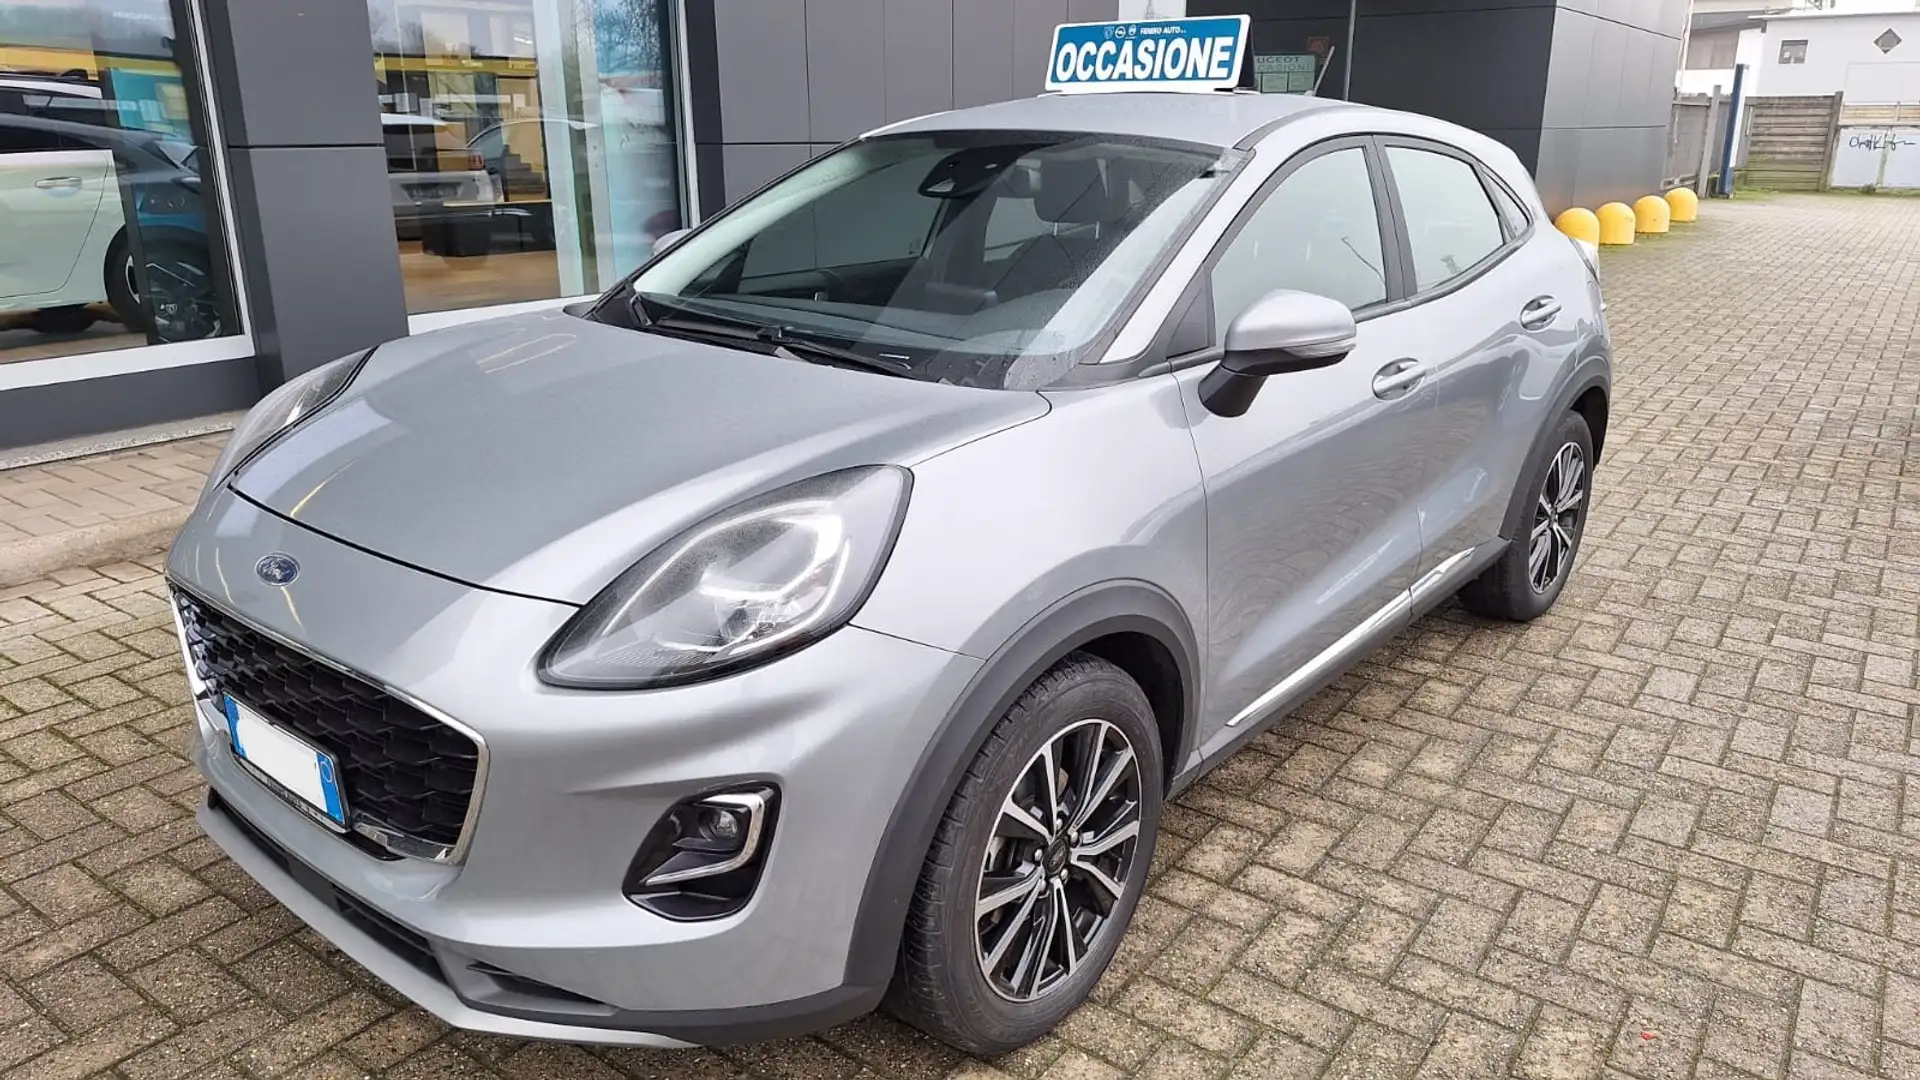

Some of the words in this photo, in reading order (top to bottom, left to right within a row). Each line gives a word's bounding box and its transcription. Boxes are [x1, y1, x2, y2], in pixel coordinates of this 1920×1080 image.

[1163, 26, 1180, 34] AUTO
[1056, 36, 1233, 82] OCCASIONE
[1257, 56, 1301, 64] UGEOT
